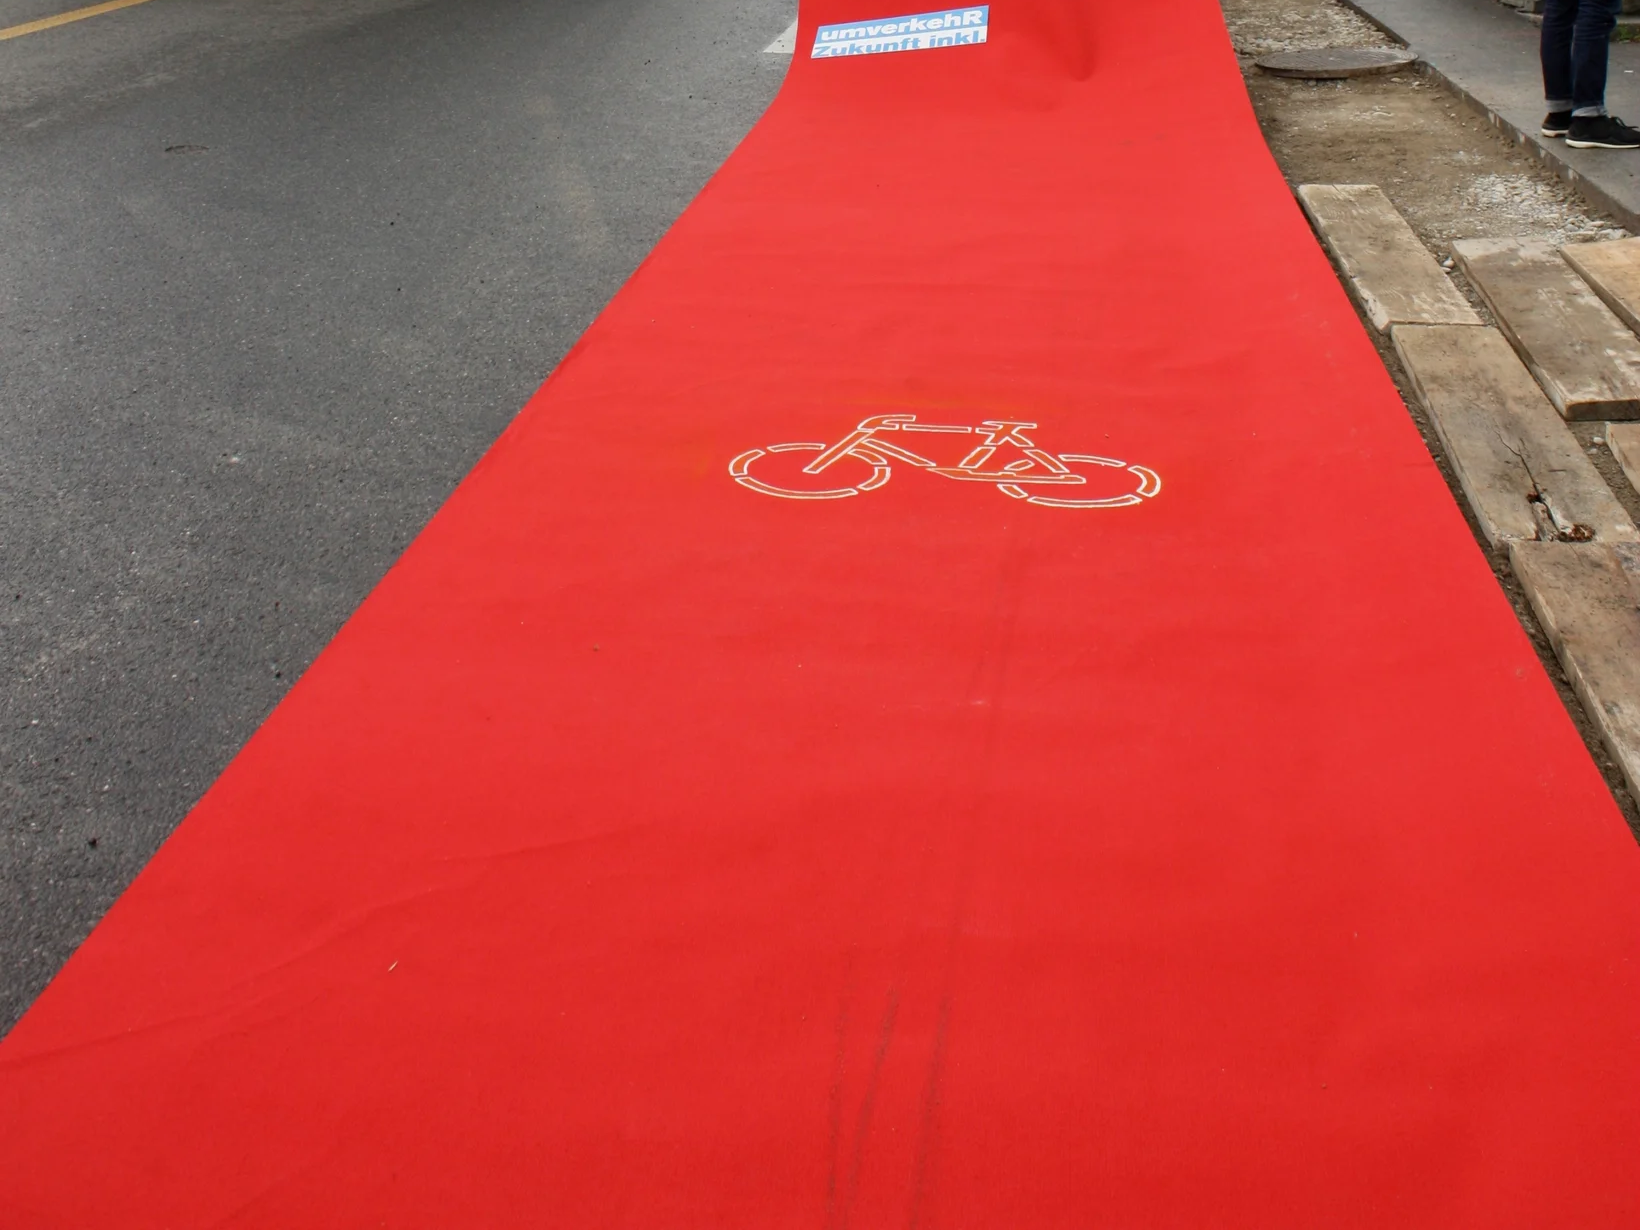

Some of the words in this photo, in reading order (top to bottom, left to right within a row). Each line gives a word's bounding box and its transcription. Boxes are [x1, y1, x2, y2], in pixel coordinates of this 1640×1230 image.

[821, 10, 983, 41] umverkehR
[813, 37, 921, 57] Zukunft
[929, 30, 986, 47] inkl.
